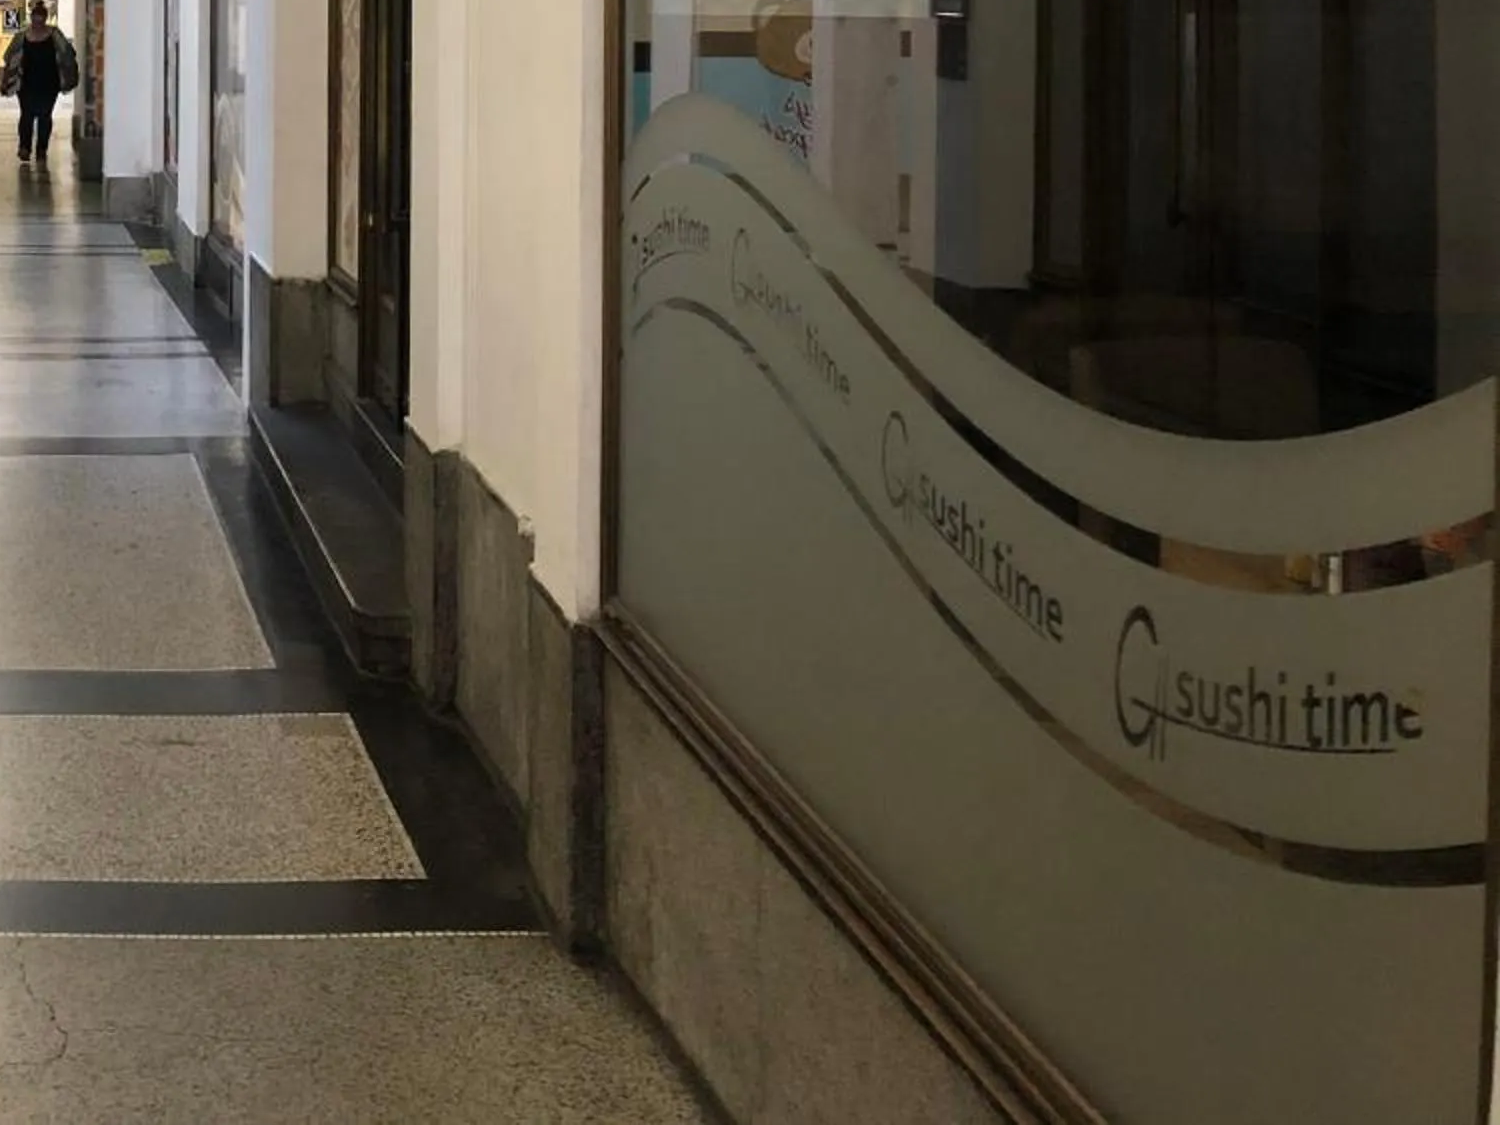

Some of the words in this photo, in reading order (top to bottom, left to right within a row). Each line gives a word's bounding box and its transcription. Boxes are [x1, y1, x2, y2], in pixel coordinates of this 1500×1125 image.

[919, 473, 985, 573] sushi
[993, 540, 1064, 644] time
[1176, 666, 1287, 743] sushi
